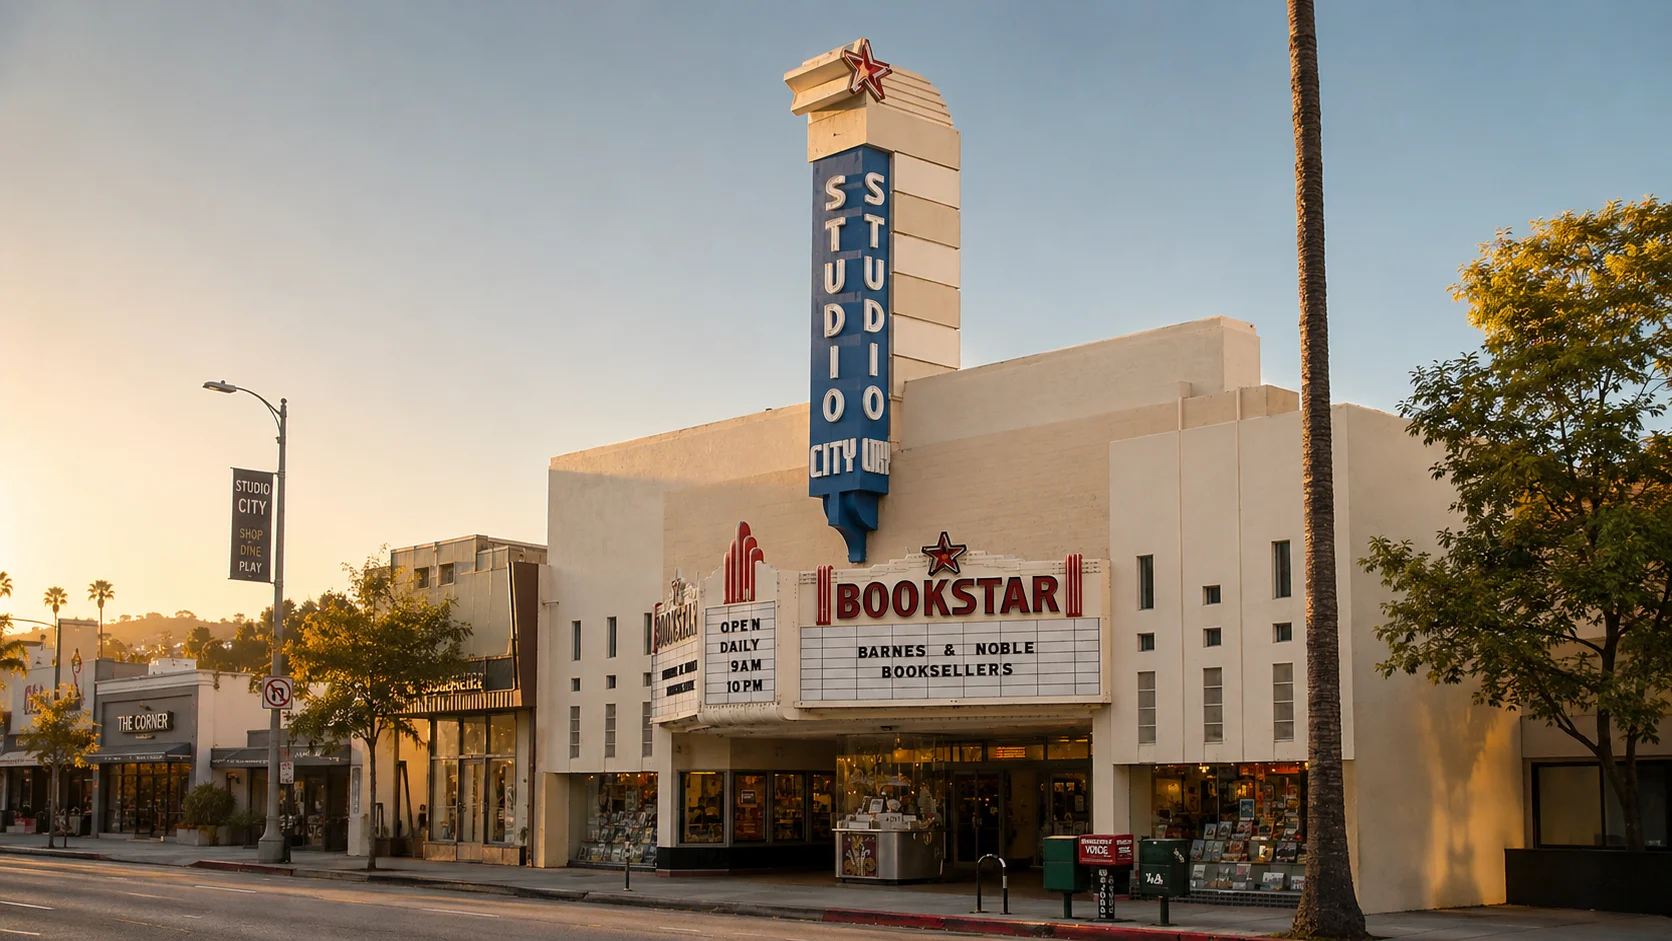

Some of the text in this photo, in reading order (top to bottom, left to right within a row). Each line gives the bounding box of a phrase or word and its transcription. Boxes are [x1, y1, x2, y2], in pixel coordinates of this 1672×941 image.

[823, 175, 846, 423] STUDIO
[863, 172, 885, 421] STUDIO
[810, 438, 857, 477] CITY
[235, 479, 270, 496] STUDIO
[238, 498, 267, 515] CITY
[240, 528, 263, 540] SHOP
[240, 544, 262, 558] DINE
[239, 560, 263, 574] PLAY
[836, 575, 1060, 620] BOOKSTAR
[720, 617, 761, 634] OPEN
[720, 638, 760, 654] DAILY
[858, 641, 1035, 659] BARNES & NOBLE
[881, 662, 1014, 679] BOOKSELLERS
[117, 712, 169, 732] THE CORNER
